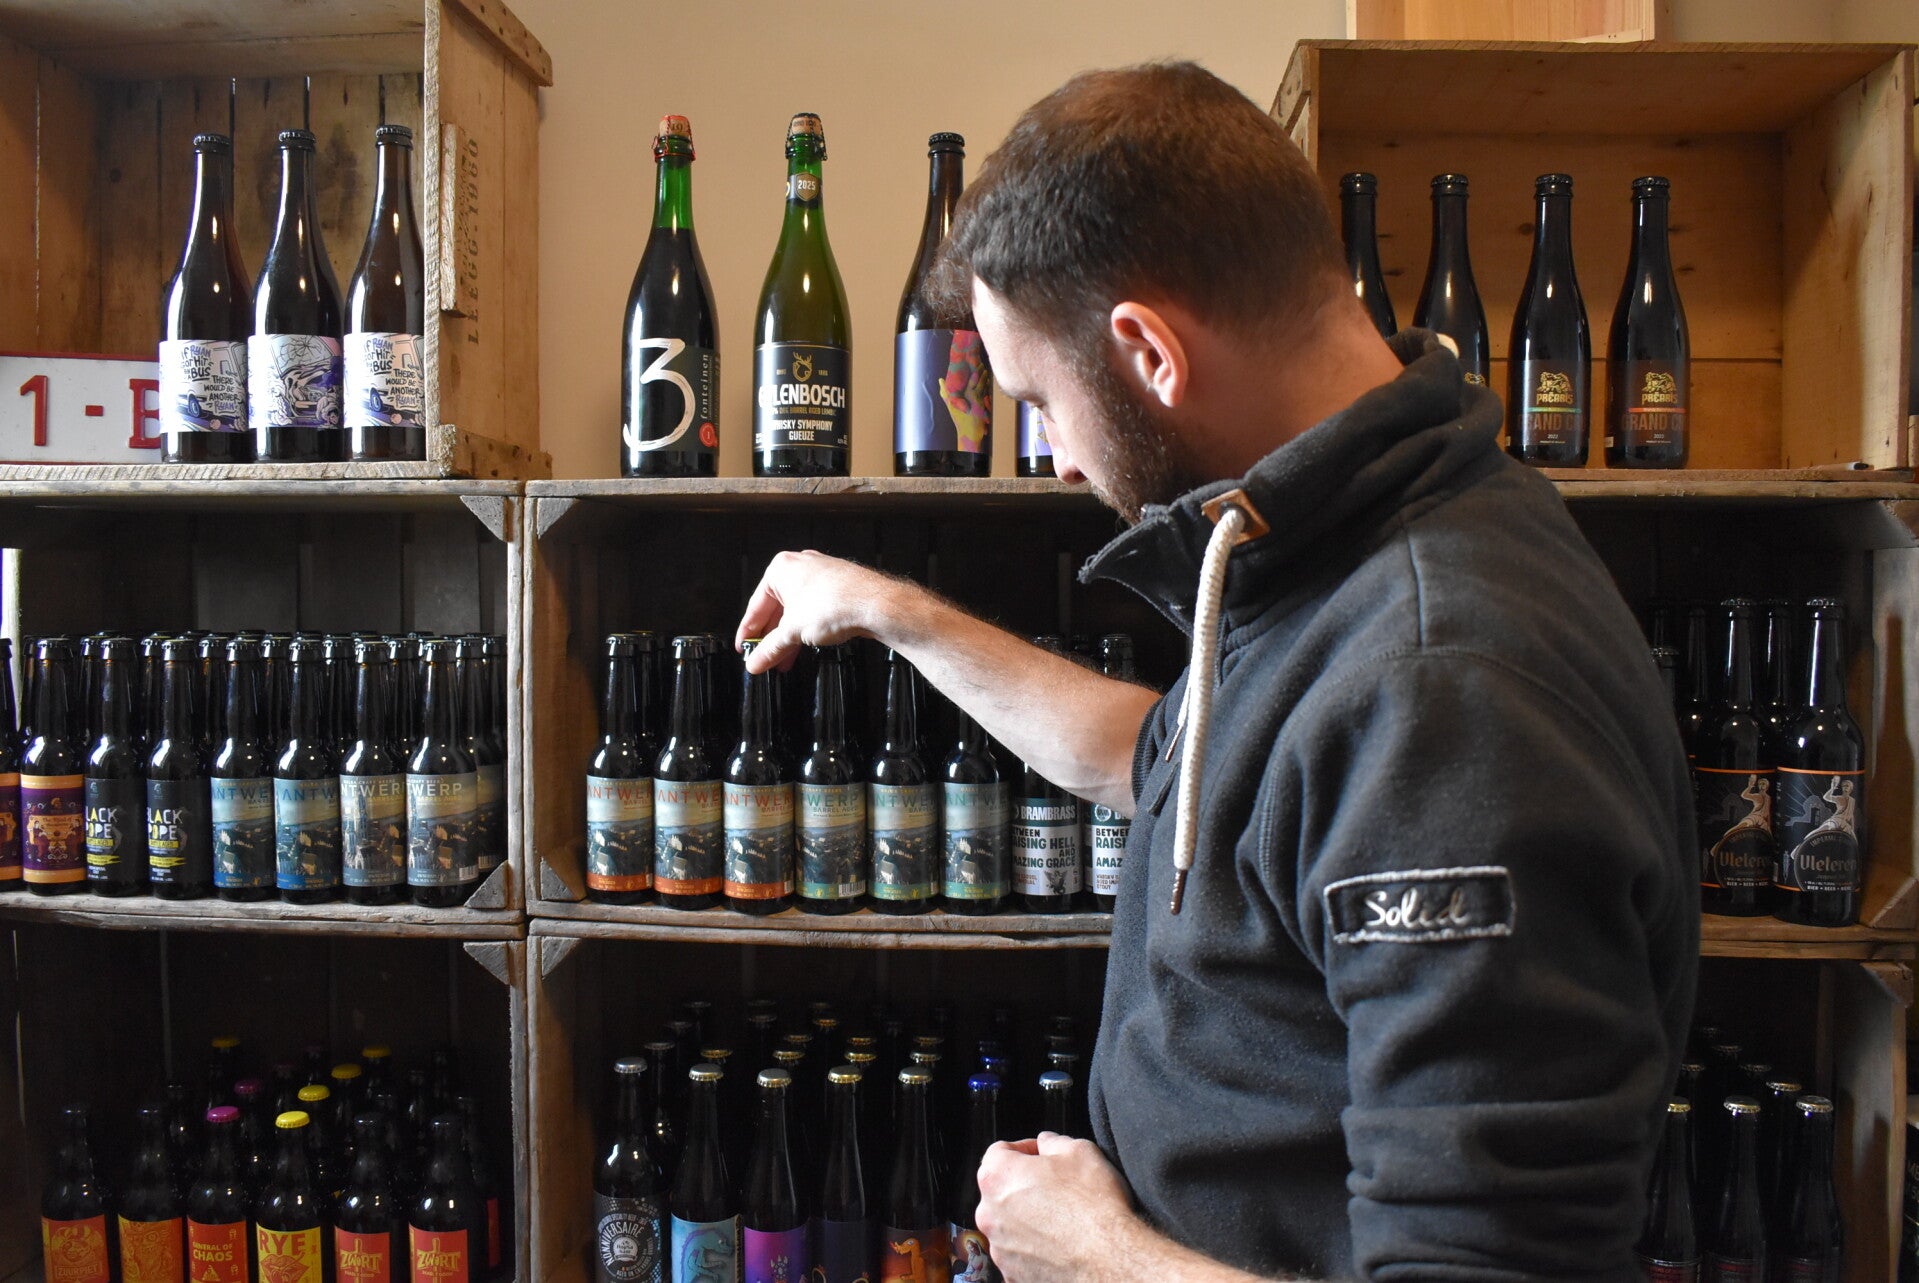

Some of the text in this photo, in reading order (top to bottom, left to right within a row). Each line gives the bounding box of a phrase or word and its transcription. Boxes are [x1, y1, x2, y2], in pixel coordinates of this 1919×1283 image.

[798, 179, 816, 190] 2025
[373, 360, 393, 372] BUS
[191, 367, 211, 379] BUS
[394, 368, 416, 379] THERE
[212, 375, 235, 386] THERE
[385, 378, 407, 386] WOULD
[391, 387, 421, 399] ANOTHER
[701, 354, 709, 420] fonteinen
[209, 393, 240, 405] ANOTHER
[758, 383, 846, 409] LENBOSCH
[772, 419, 833, 432] HISKY SYMPHONY
[788, 430, 815, 441] GUEUZE
[1020, 804, 1076, 821] BRAMBRASS
[1049, 836, 1076, 850] HELL
[1058, 847, 1076, 858] AND
[1045, 856, 1076, 868] GRACE
[1363, 886, 1473, 929] Solid
[259, 1229, 306, 1256] RYE
[193, 1249, 233, 1262] CHAOS
[58, 1264, 98, 1277] ZUURPIET
